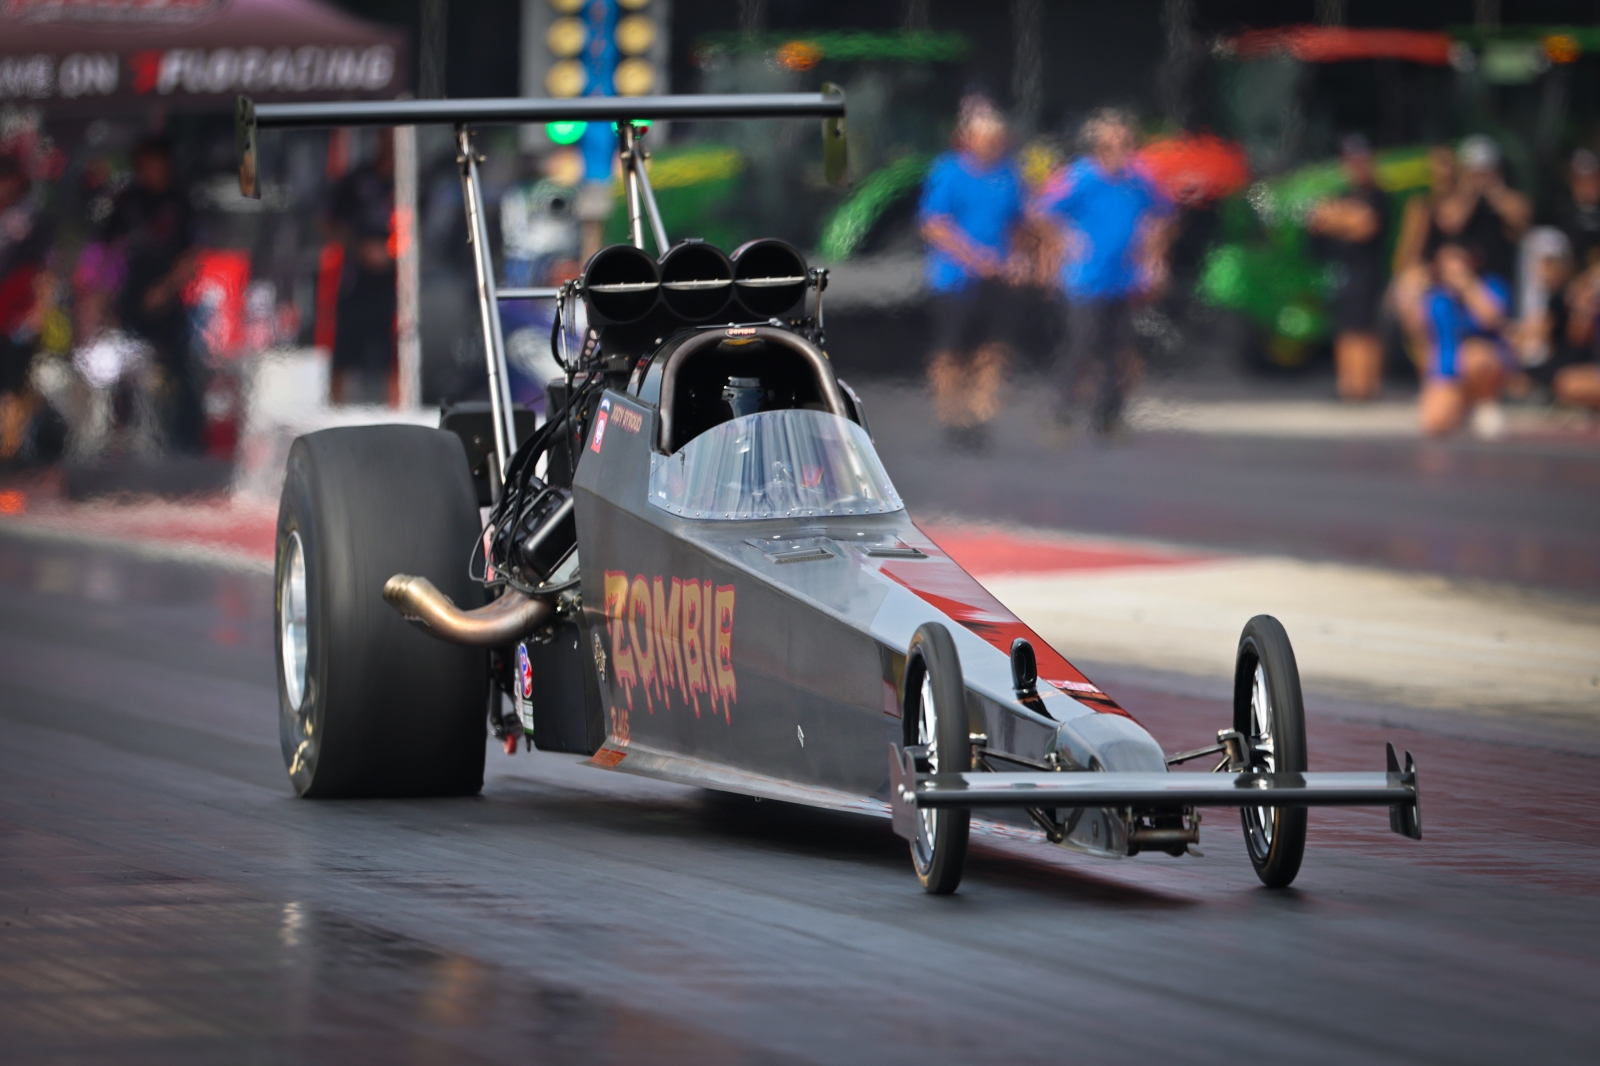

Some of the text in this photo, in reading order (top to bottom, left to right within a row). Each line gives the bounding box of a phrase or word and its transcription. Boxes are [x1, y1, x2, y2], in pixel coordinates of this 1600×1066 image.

[59, 51, 120, 98] ON
[156, 43, 396, 95] FLORACING
[604, 569, 738, 724] ZOMBIE
